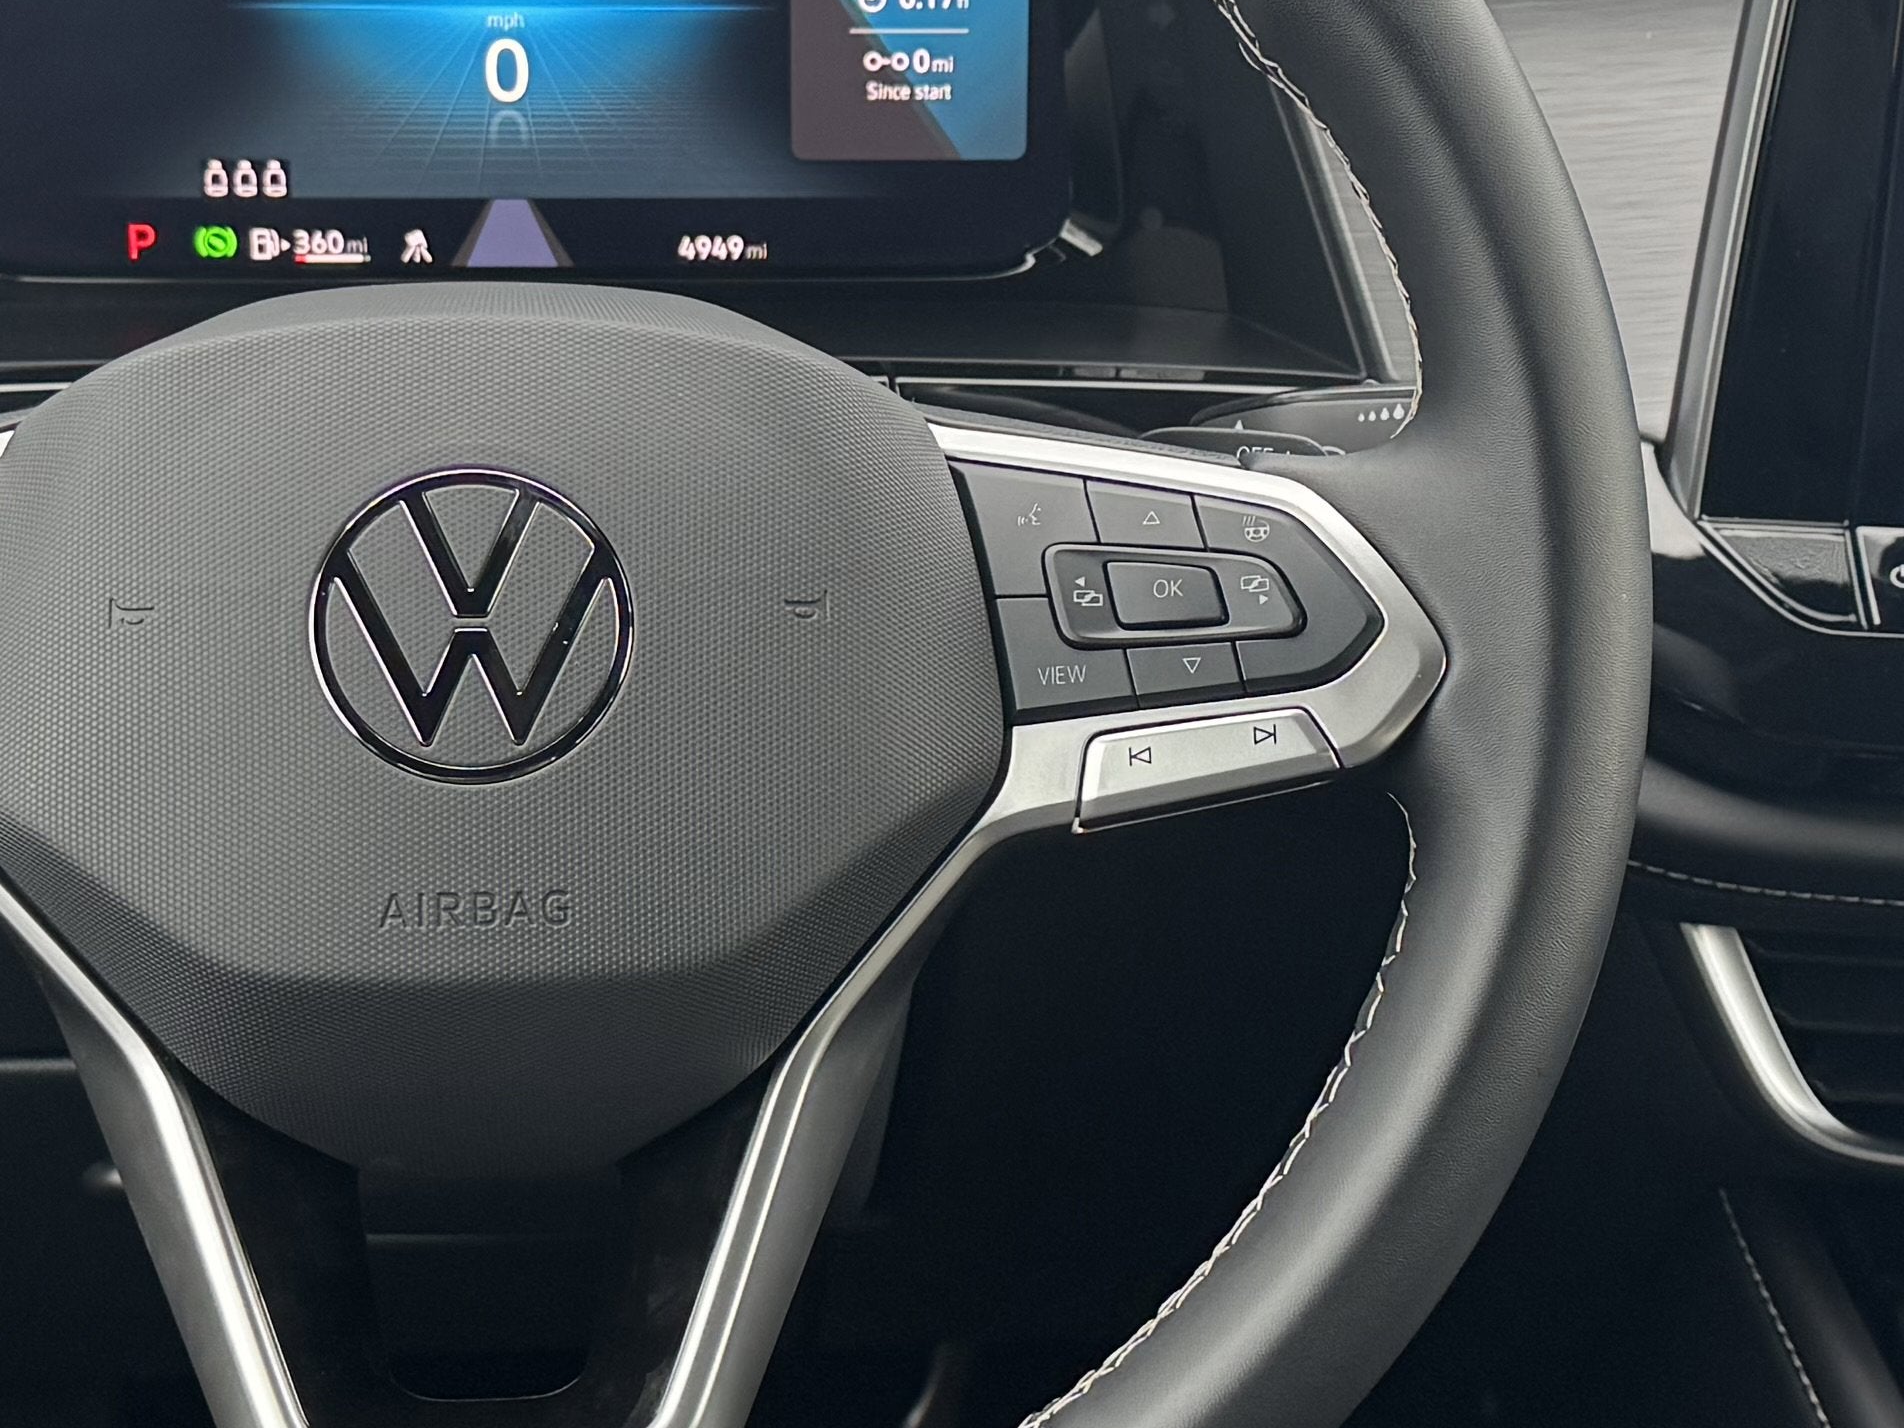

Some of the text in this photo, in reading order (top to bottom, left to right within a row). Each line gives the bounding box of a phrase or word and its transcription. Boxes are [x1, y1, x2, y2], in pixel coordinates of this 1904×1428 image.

[486, 11, 525, 31] mph
[485, 38, 530, 103] 0
[865, 79, 953, 101] Since start
[127, 223, 157, 261] P
[1152, 578, 1183, 599] OK
[1037, 664, 1087, 686] VIEW
[378, 889, 573, 929] AIRBAG
